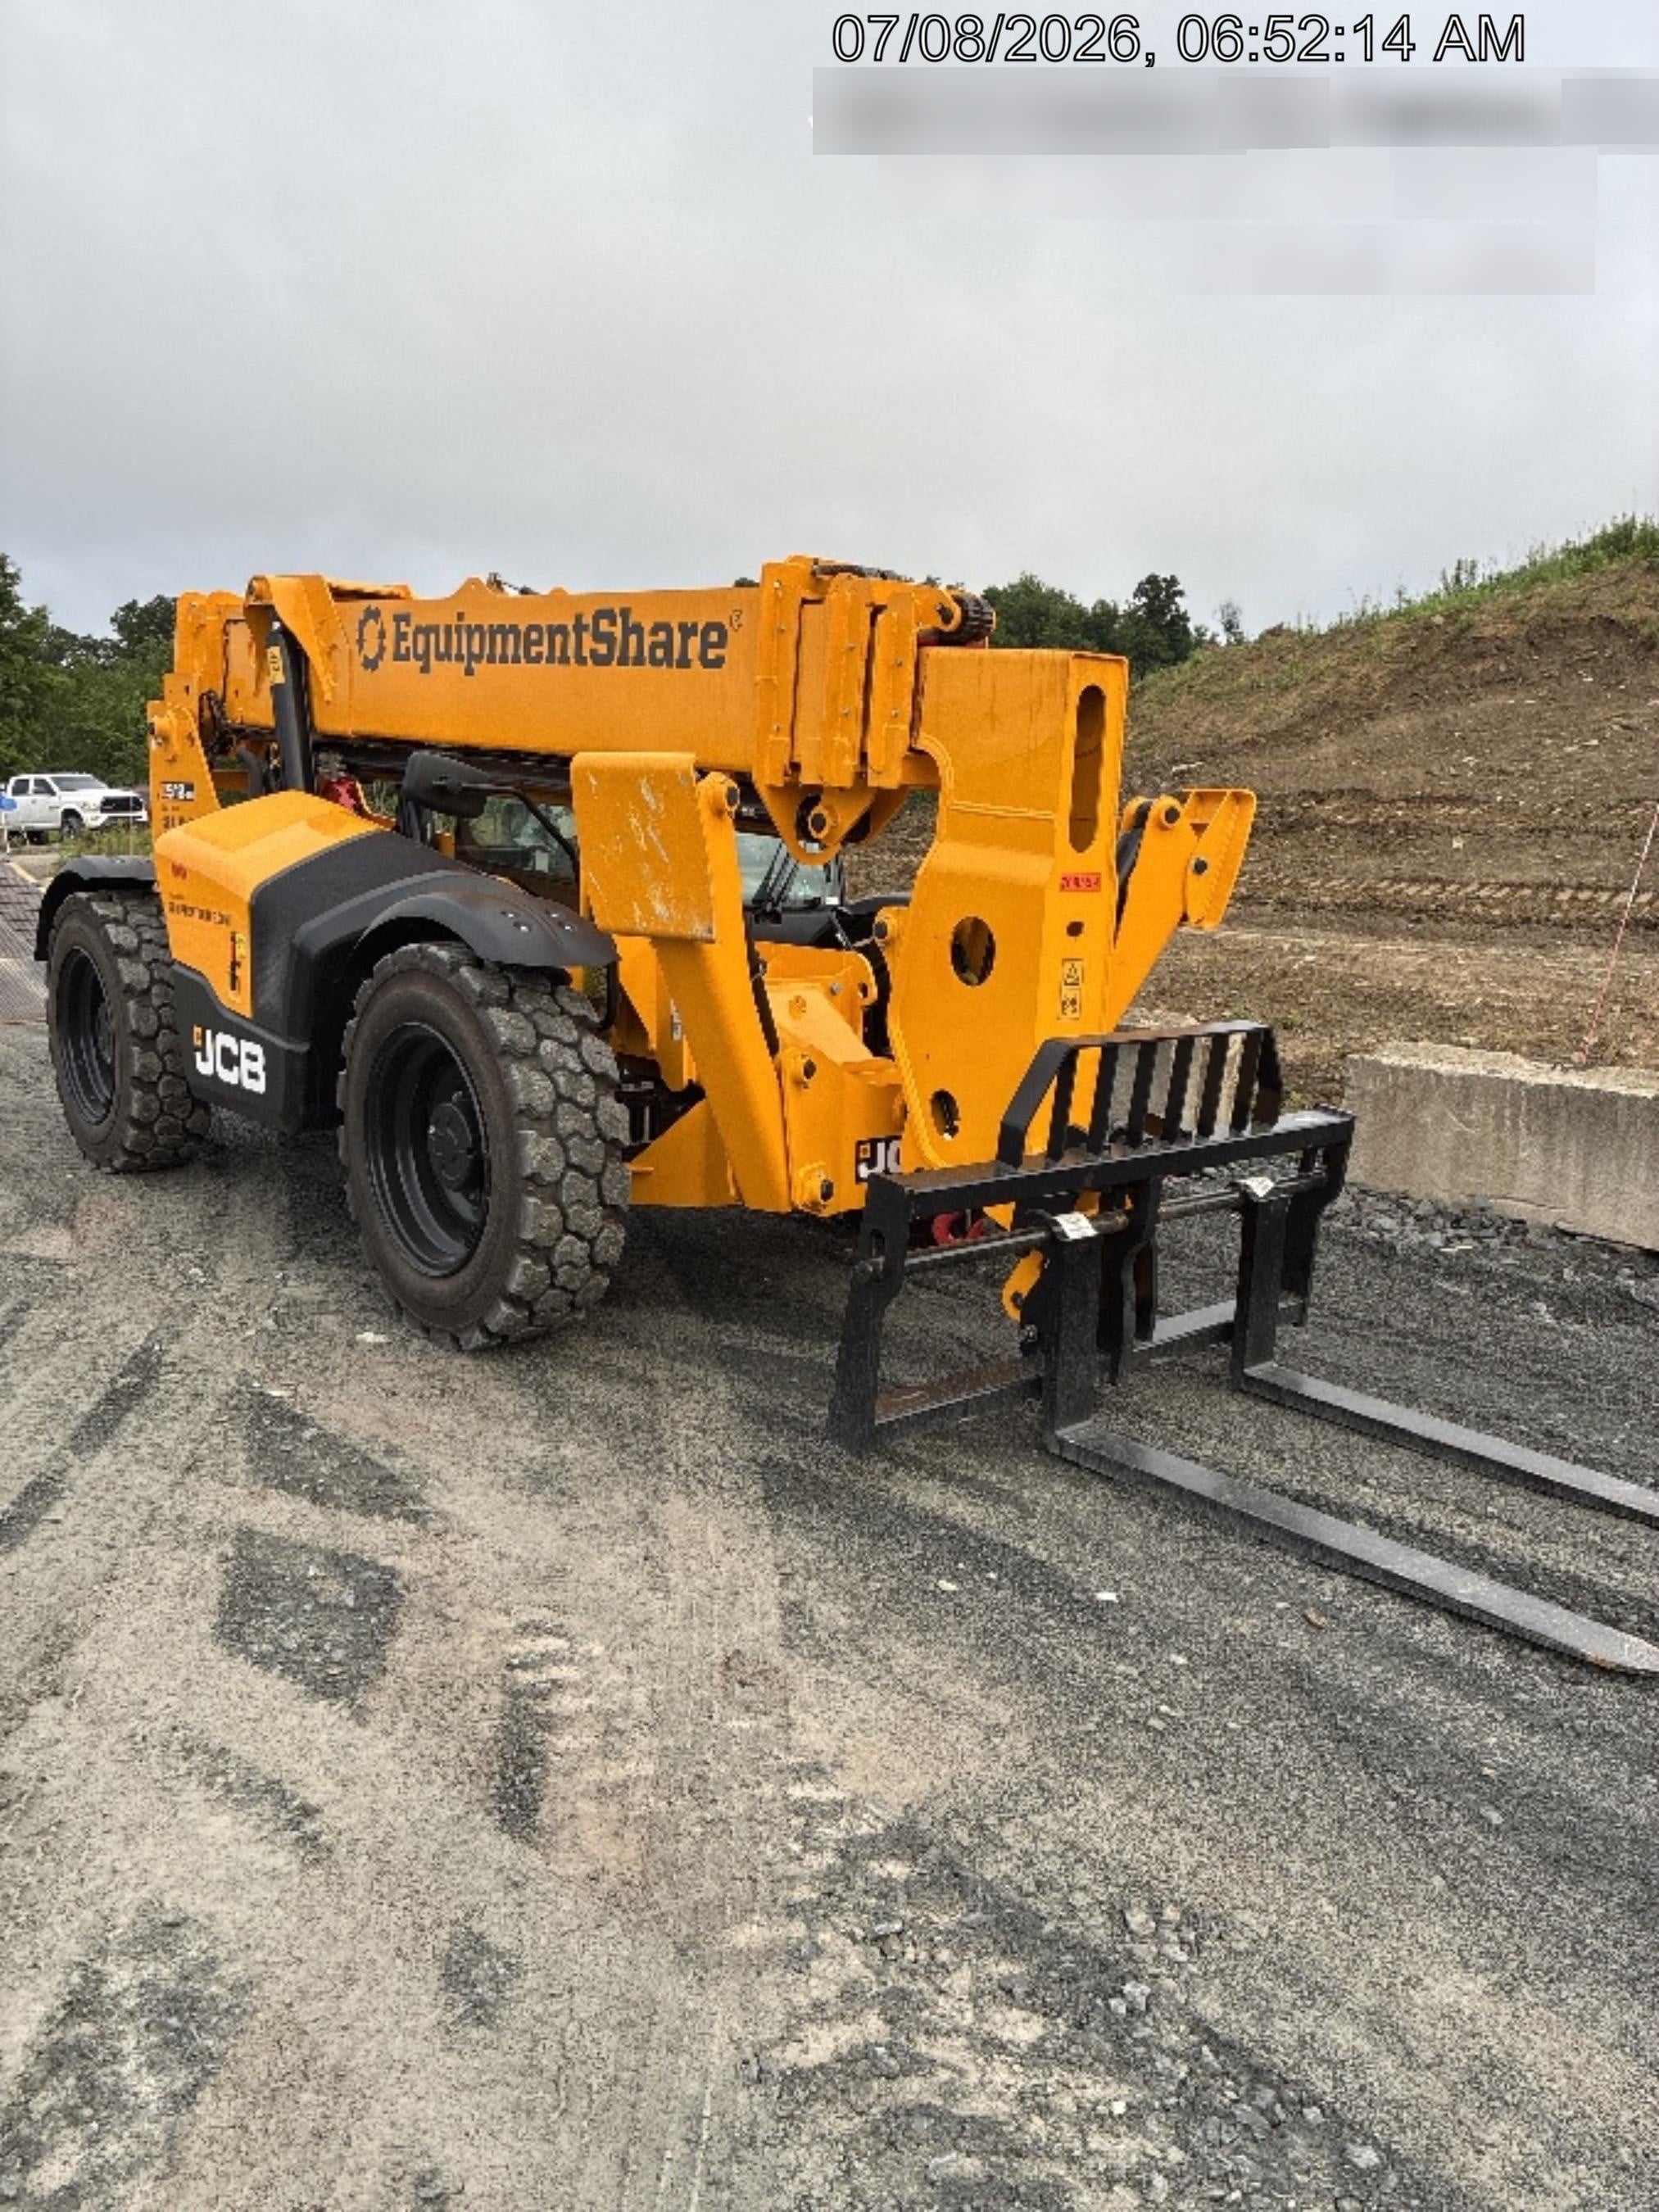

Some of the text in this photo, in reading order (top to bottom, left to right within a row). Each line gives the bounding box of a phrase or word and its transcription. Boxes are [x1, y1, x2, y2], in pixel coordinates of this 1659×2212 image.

[393, 607, 728, 676] EquipmentShare
[195, 1029, 265, 1095] JCB
[857, 1140, 902, 1179] JC
